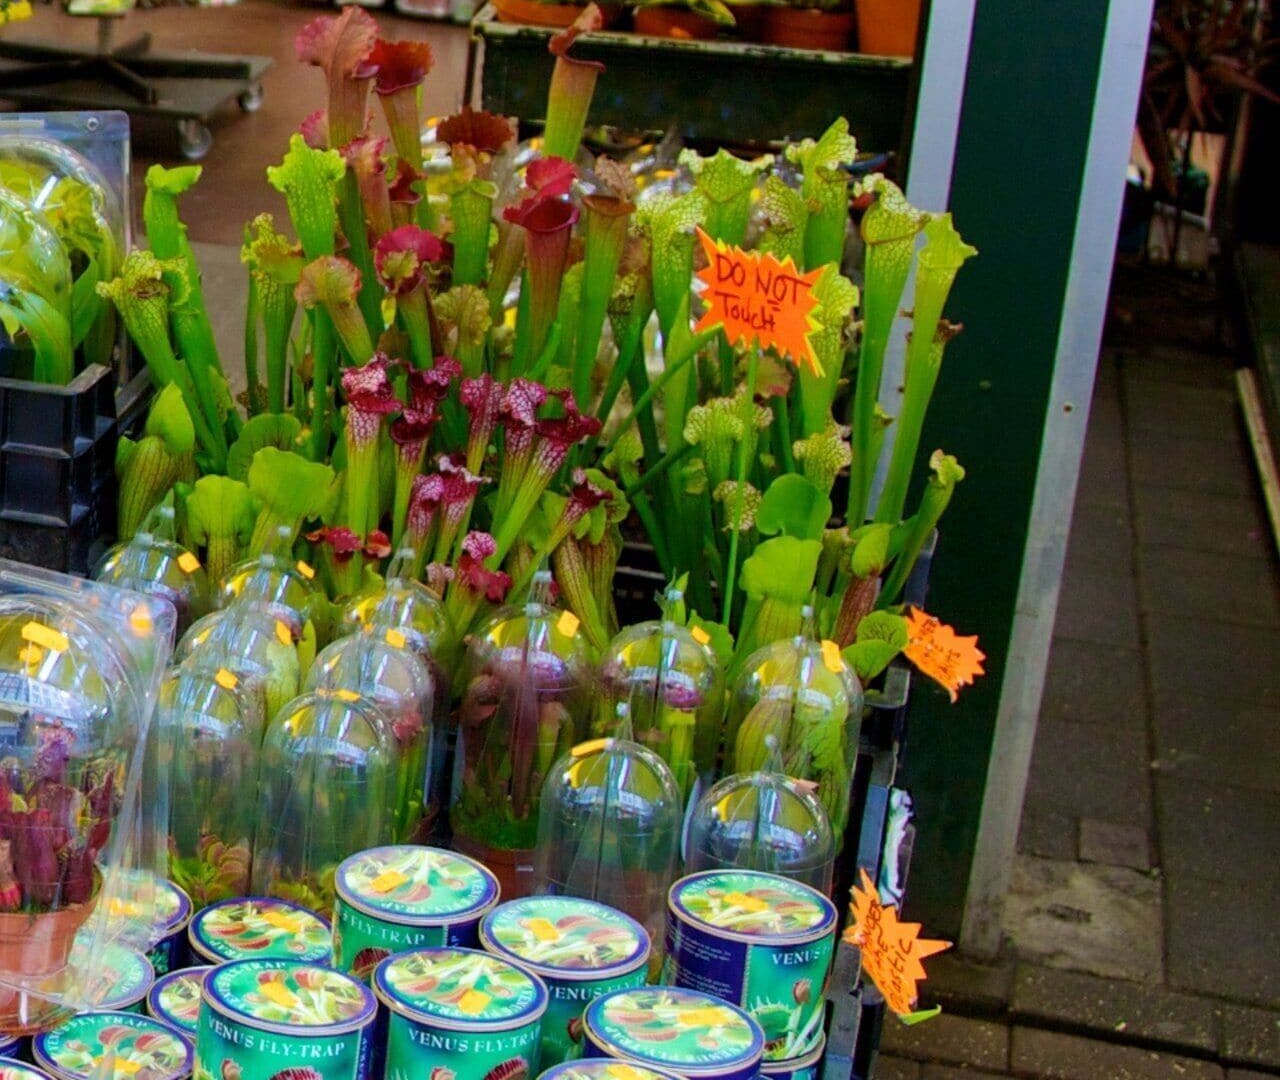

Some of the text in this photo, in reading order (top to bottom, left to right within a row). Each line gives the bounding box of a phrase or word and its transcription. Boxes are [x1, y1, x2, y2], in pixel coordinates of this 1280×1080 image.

[716, 253, 813, 306] DO NOT
[350, 916, 425, 946] FLY-TRAP
[208, 1014, 255, 1050] VENUS
[258, 1039, 346, 1059] FLY-TRAP
[409, 1027, 470, 1053] VENUS
